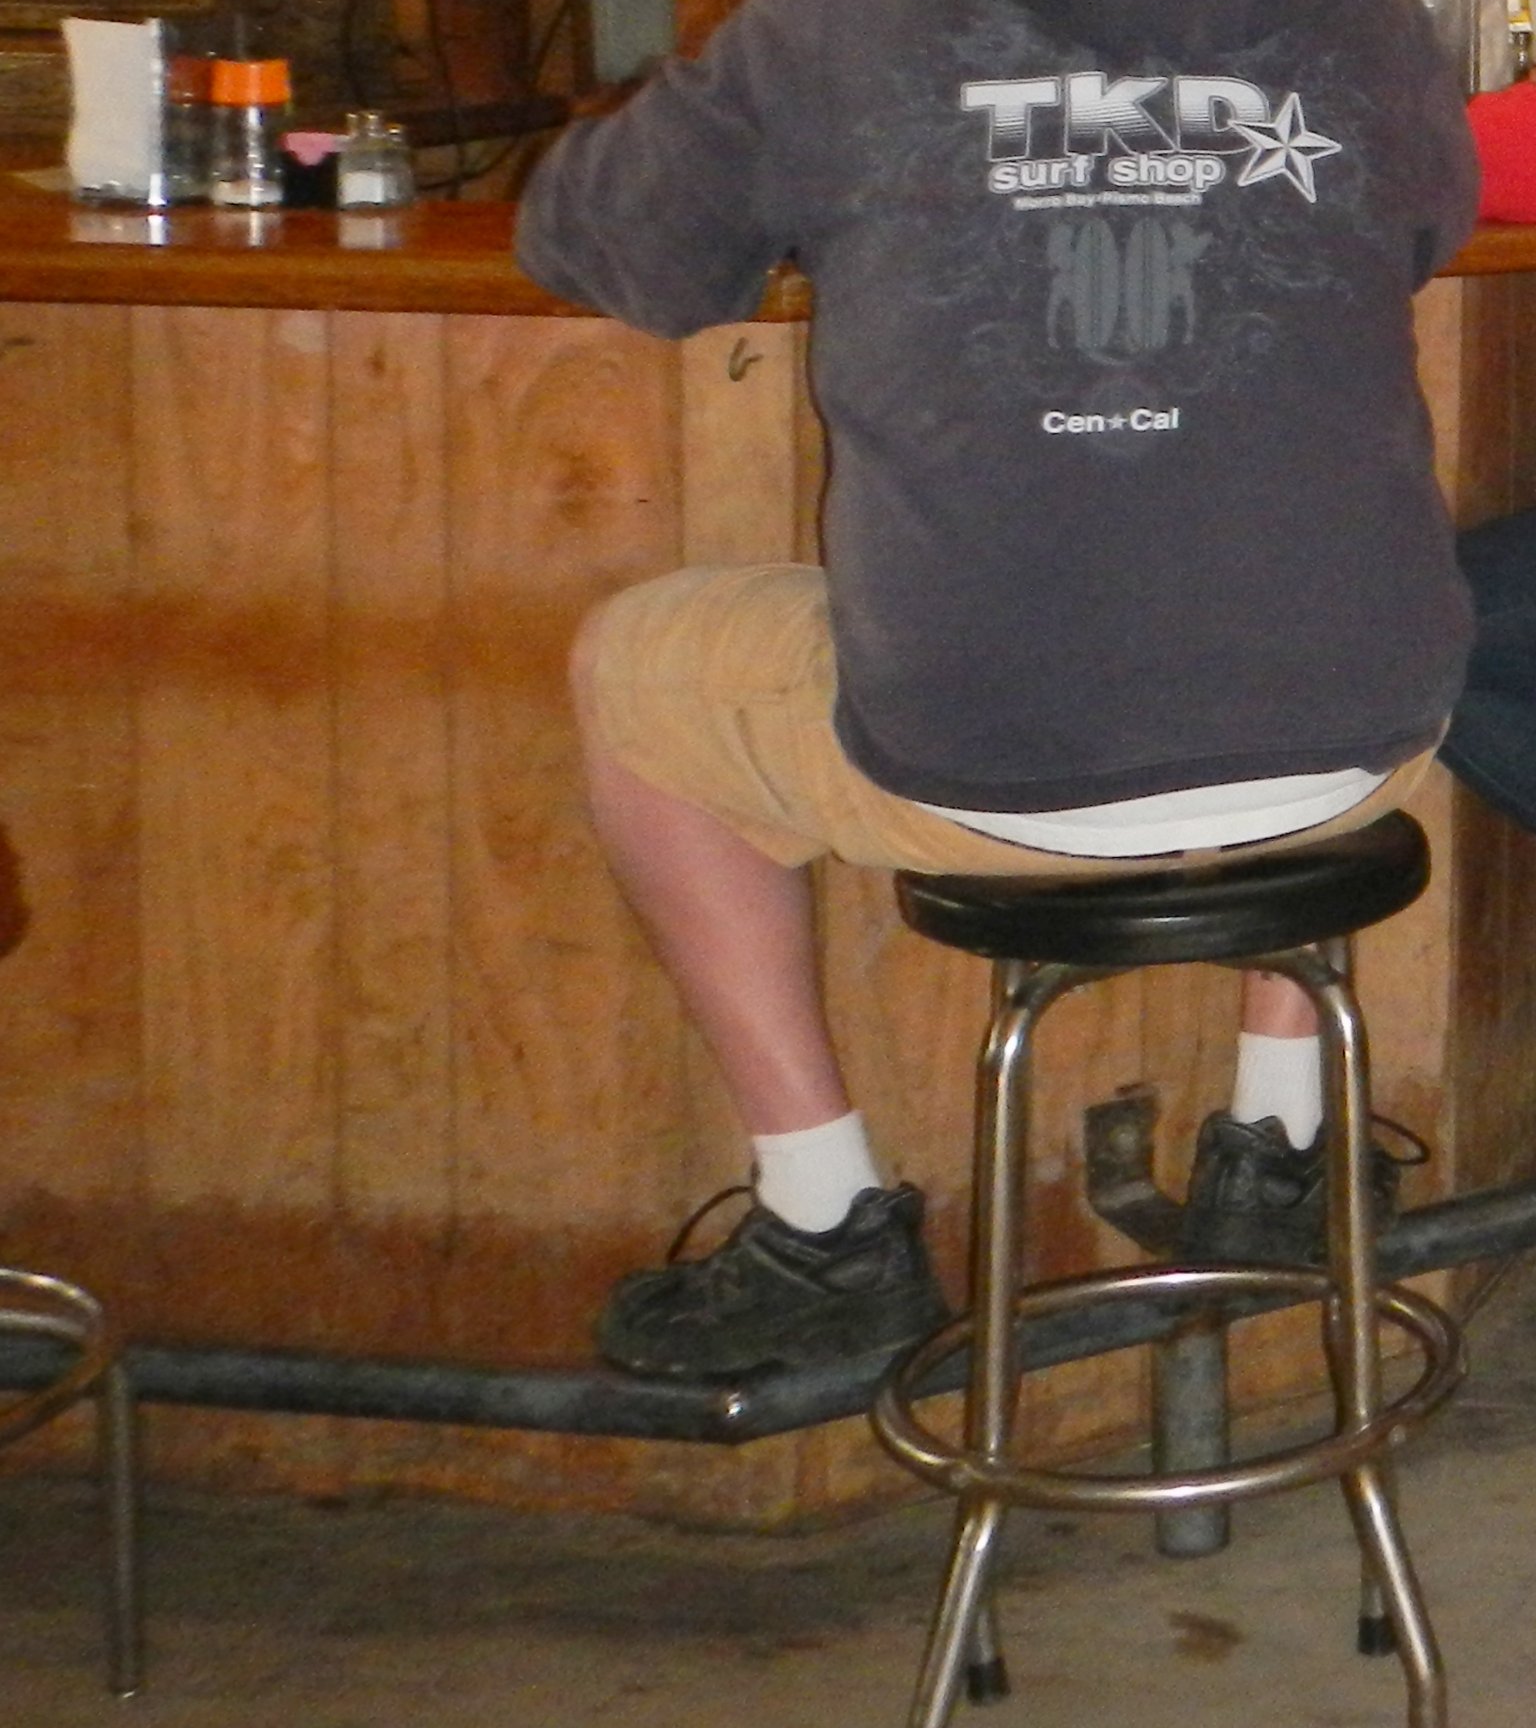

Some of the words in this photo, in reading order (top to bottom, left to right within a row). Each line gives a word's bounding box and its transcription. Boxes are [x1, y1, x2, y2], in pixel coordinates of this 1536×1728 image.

[961, 71, 1271, 162] TKD
[988, 155, 1096, 193] surf
[1107, 153, 1226, 192] shop
[1041, 411, 1106, 435] Cen
[1129, 407, 1180, 432] Cal
